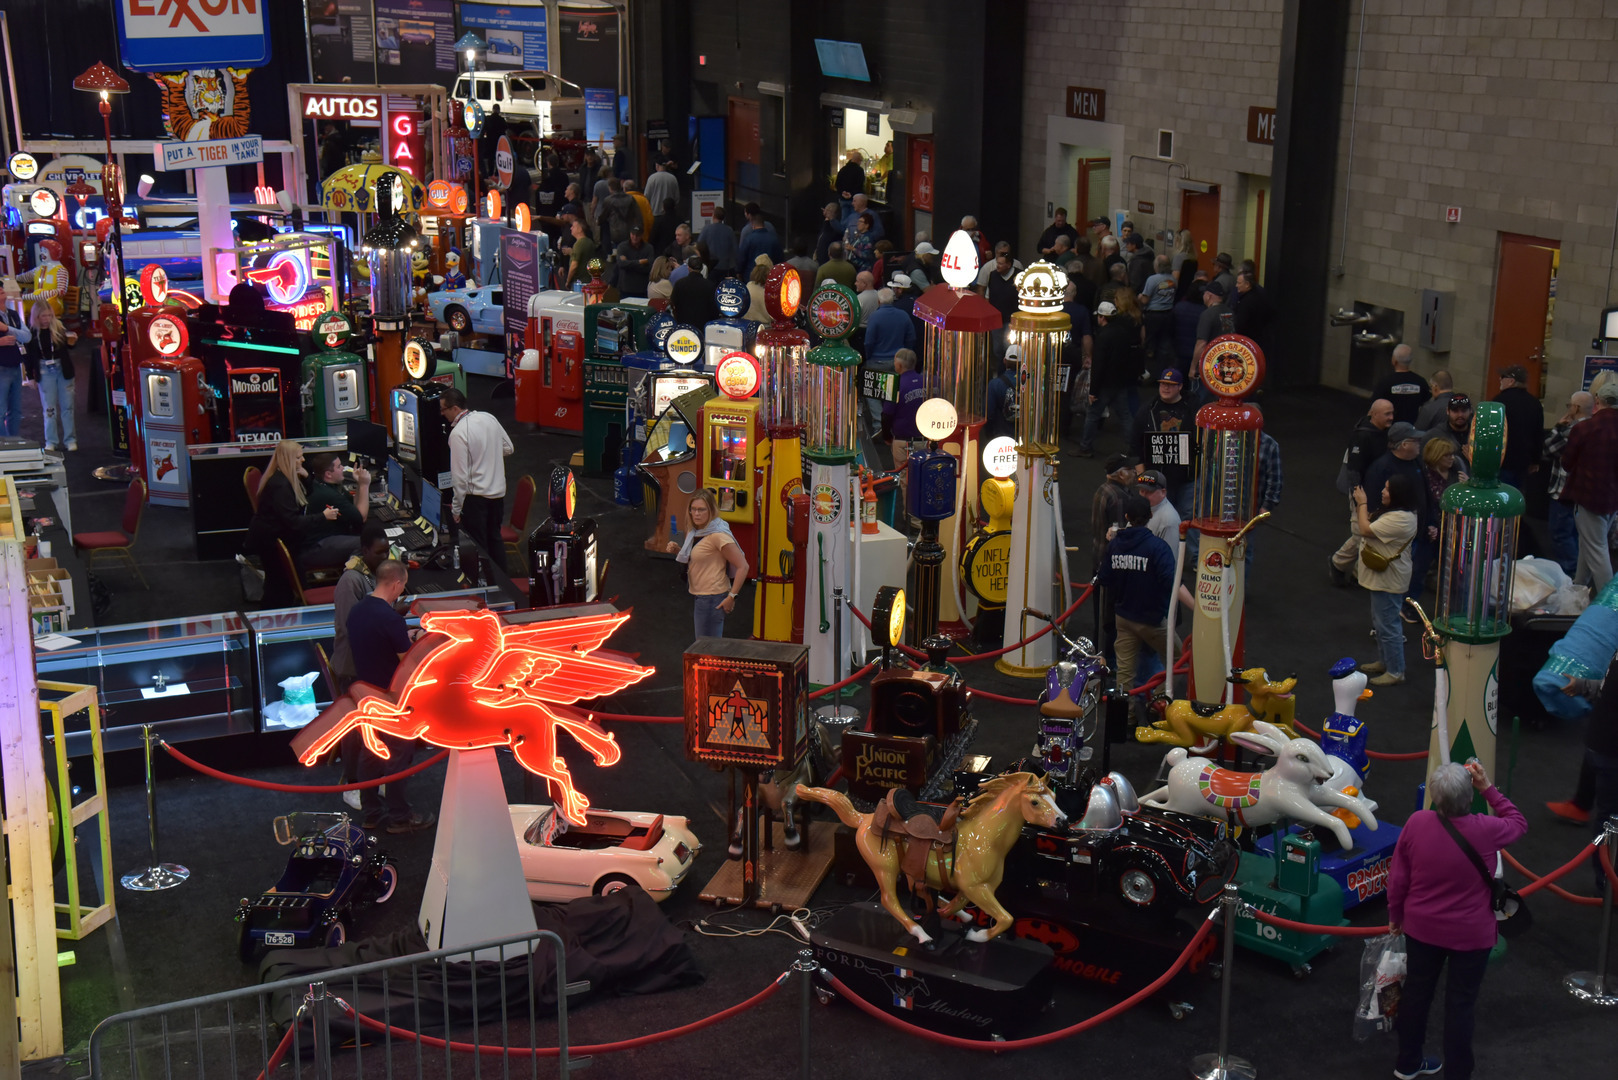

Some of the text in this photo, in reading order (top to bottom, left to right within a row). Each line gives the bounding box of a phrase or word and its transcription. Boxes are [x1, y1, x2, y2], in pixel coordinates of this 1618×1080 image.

[305, 97, 378, 117] AUTOS
[1073, 91, 1098, 116] MEN
[231, 139, 259, 152] IN YOUR
[167, 147, 194, 161] PUT A
[198, 145, 228, 161] TIGER
[235, 148, 259, 160] TANK!
[497, 153, 512, 171] Gulf
[431, 189, 449, 199] GULF
[941, 253, 961, 270] ELL
[812, 292, 849, 312] SINCLAIR
[671, 344, 698, 353] SUNOCO
[1228, 343, 1254, 367] GRAVITY
[725, 377, 748, 387] CORN
[864, 371, 875, 380] GAS
[232, 377, 278, 393] MOTOR OIL
[864, 380, 874, 388] TAX
[931, 419, 956, 429] POLICE
[238, 432, 282, 443] TEXACO
[1151, 435, 1164, 445] GAS
[1151, 445, 1164, 455] TAX
[993, 454, 1017, 463] FREE
[976, 563, 1002, 577] YOUR
[1111, 555, 1149, 571] SECURITY
[1201, 574, 1221, 582] GILMO
[1198, 581, 1234, 595] RED LIN
[1200, 593, 1220, 601] GASOLI
[1043, 725, 1072, 733] Indian
[862, 743, 905, 764] UNION
[856, 755, 907, 782] PACIFIC
[817, 950, 865, 969] FORD
[916, 1000, 993, 1026] Mustang
